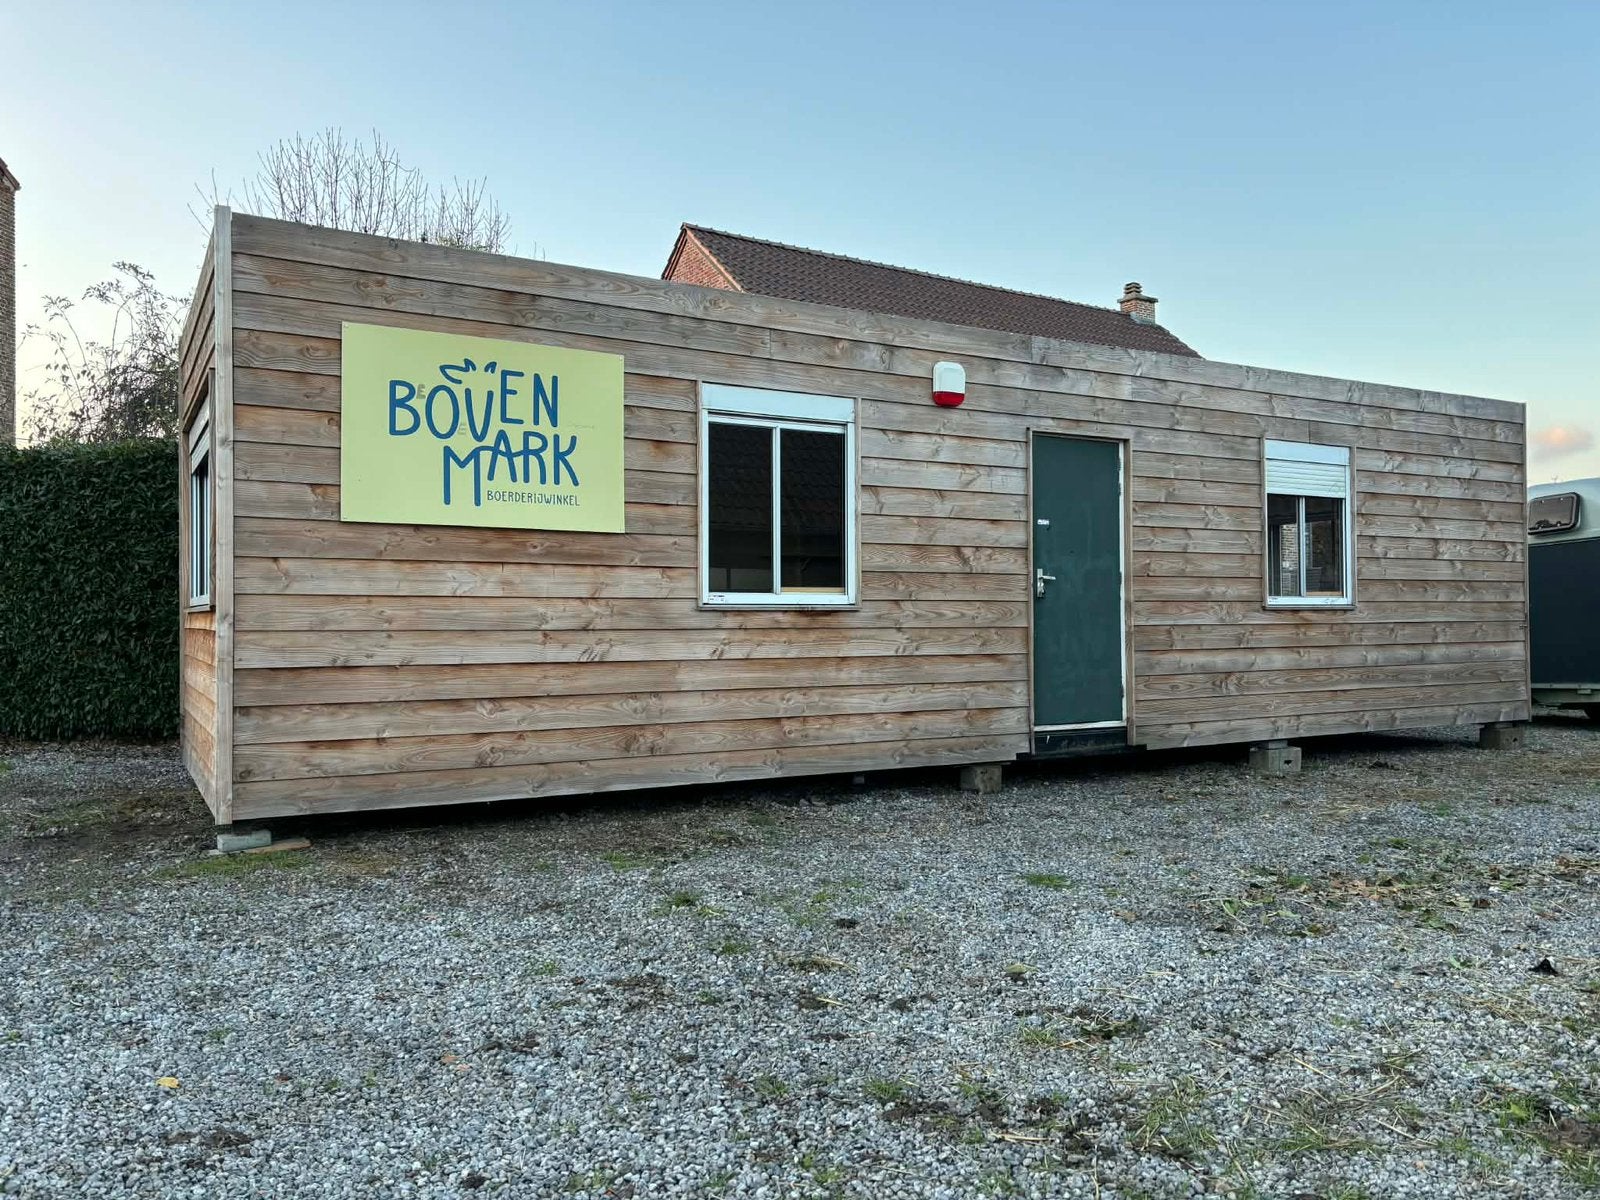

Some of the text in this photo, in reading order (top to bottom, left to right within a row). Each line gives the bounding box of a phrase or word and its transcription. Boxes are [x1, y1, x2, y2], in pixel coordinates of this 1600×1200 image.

[389, 369, 559, 442] BOVEN
[443, 429, 580, 508] MARK
[487, 490, 580, 506] BOERDERIJWINKEL
